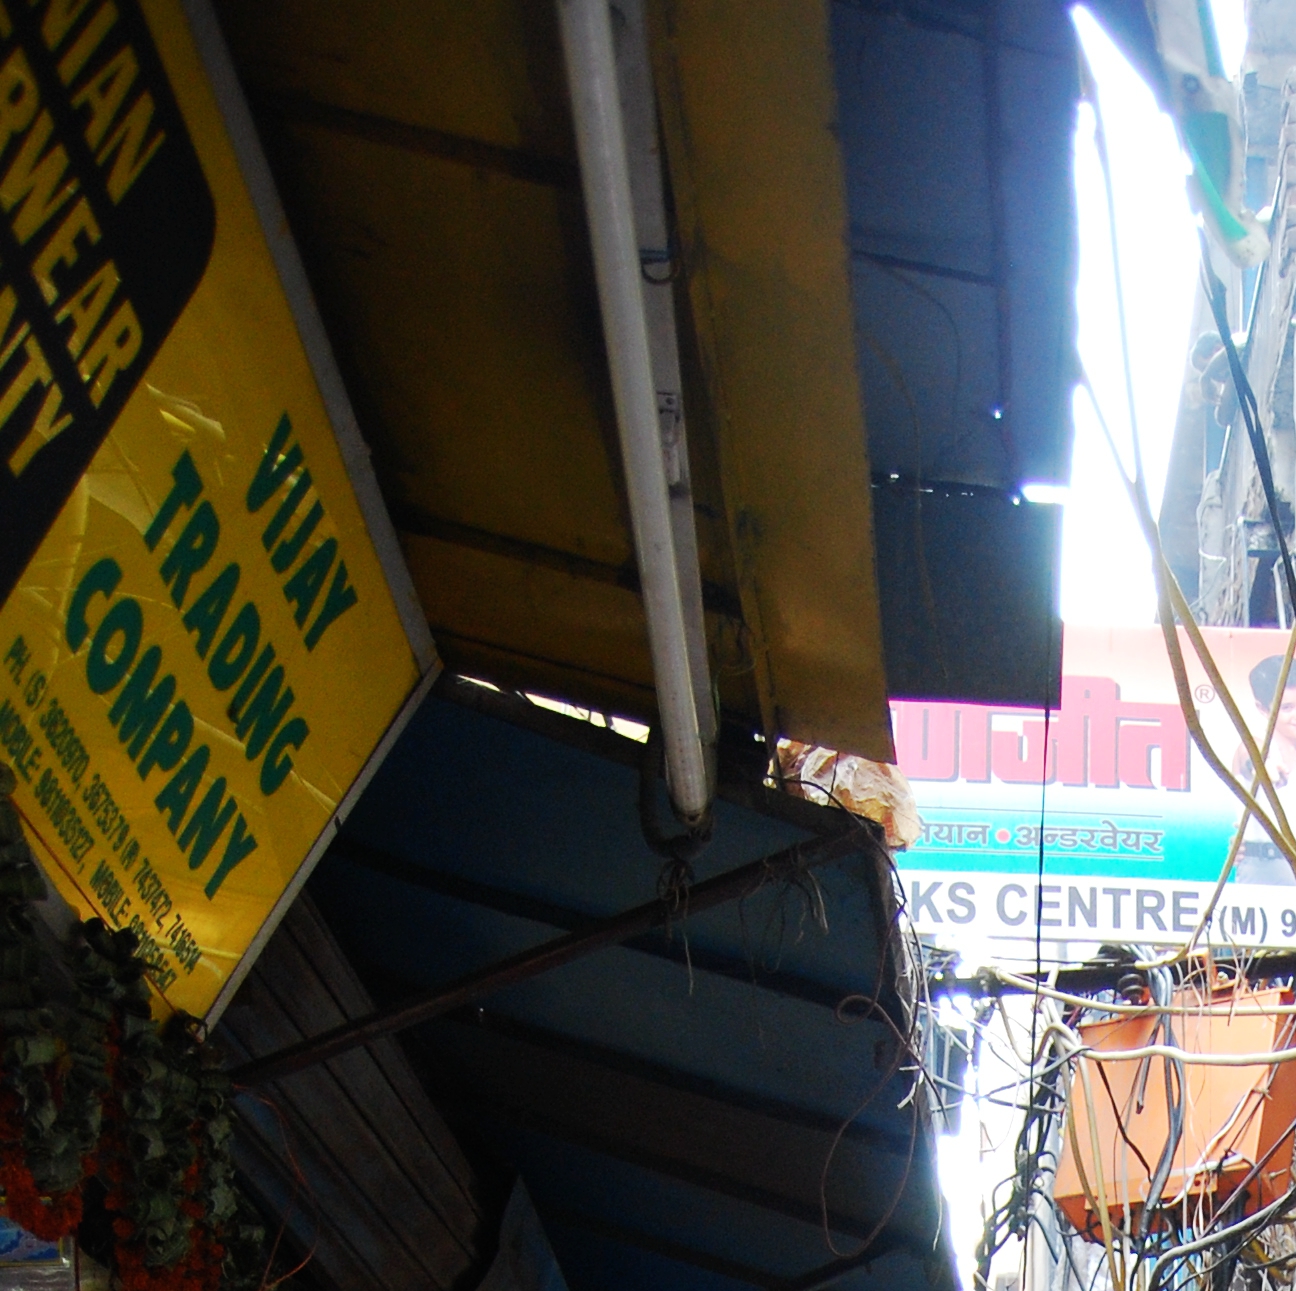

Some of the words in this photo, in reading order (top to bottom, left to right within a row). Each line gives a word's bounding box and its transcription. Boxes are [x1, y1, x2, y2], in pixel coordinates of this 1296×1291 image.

[0, 12, 143, 410] RWEAR
[145, 449, 310, 796] TRADING
[246, 414, 359, 652] VIJAY
[65, 558, 259, 901] COMPANY
[996, 883, 1200, 933] CENTRE
[1218, 906, 1268, 944] (M)
